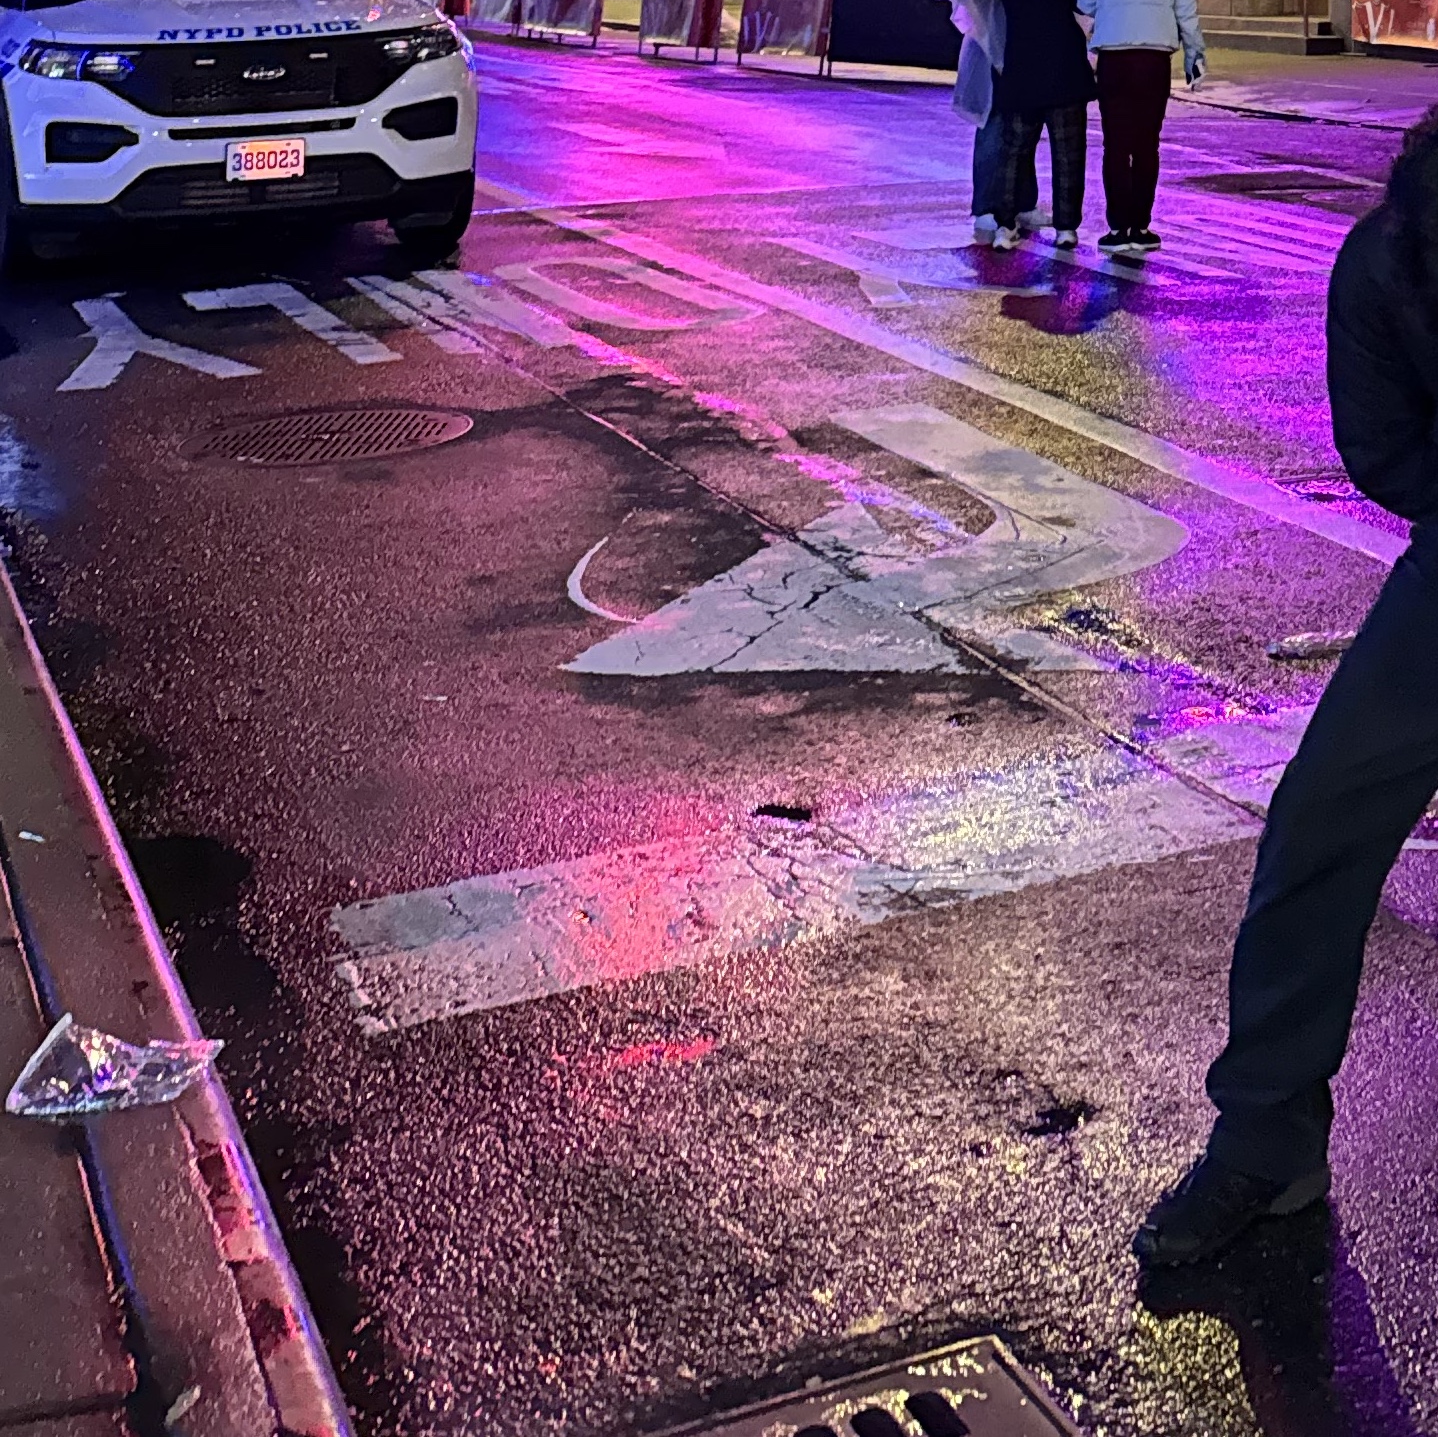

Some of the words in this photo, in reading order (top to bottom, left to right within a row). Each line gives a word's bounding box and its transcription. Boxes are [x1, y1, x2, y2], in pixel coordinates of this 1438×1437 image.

[157, 26, 245, 41] NYPD
[253, 19, 362, 38] POLICE
[232, 148, 301, 172] 388023
